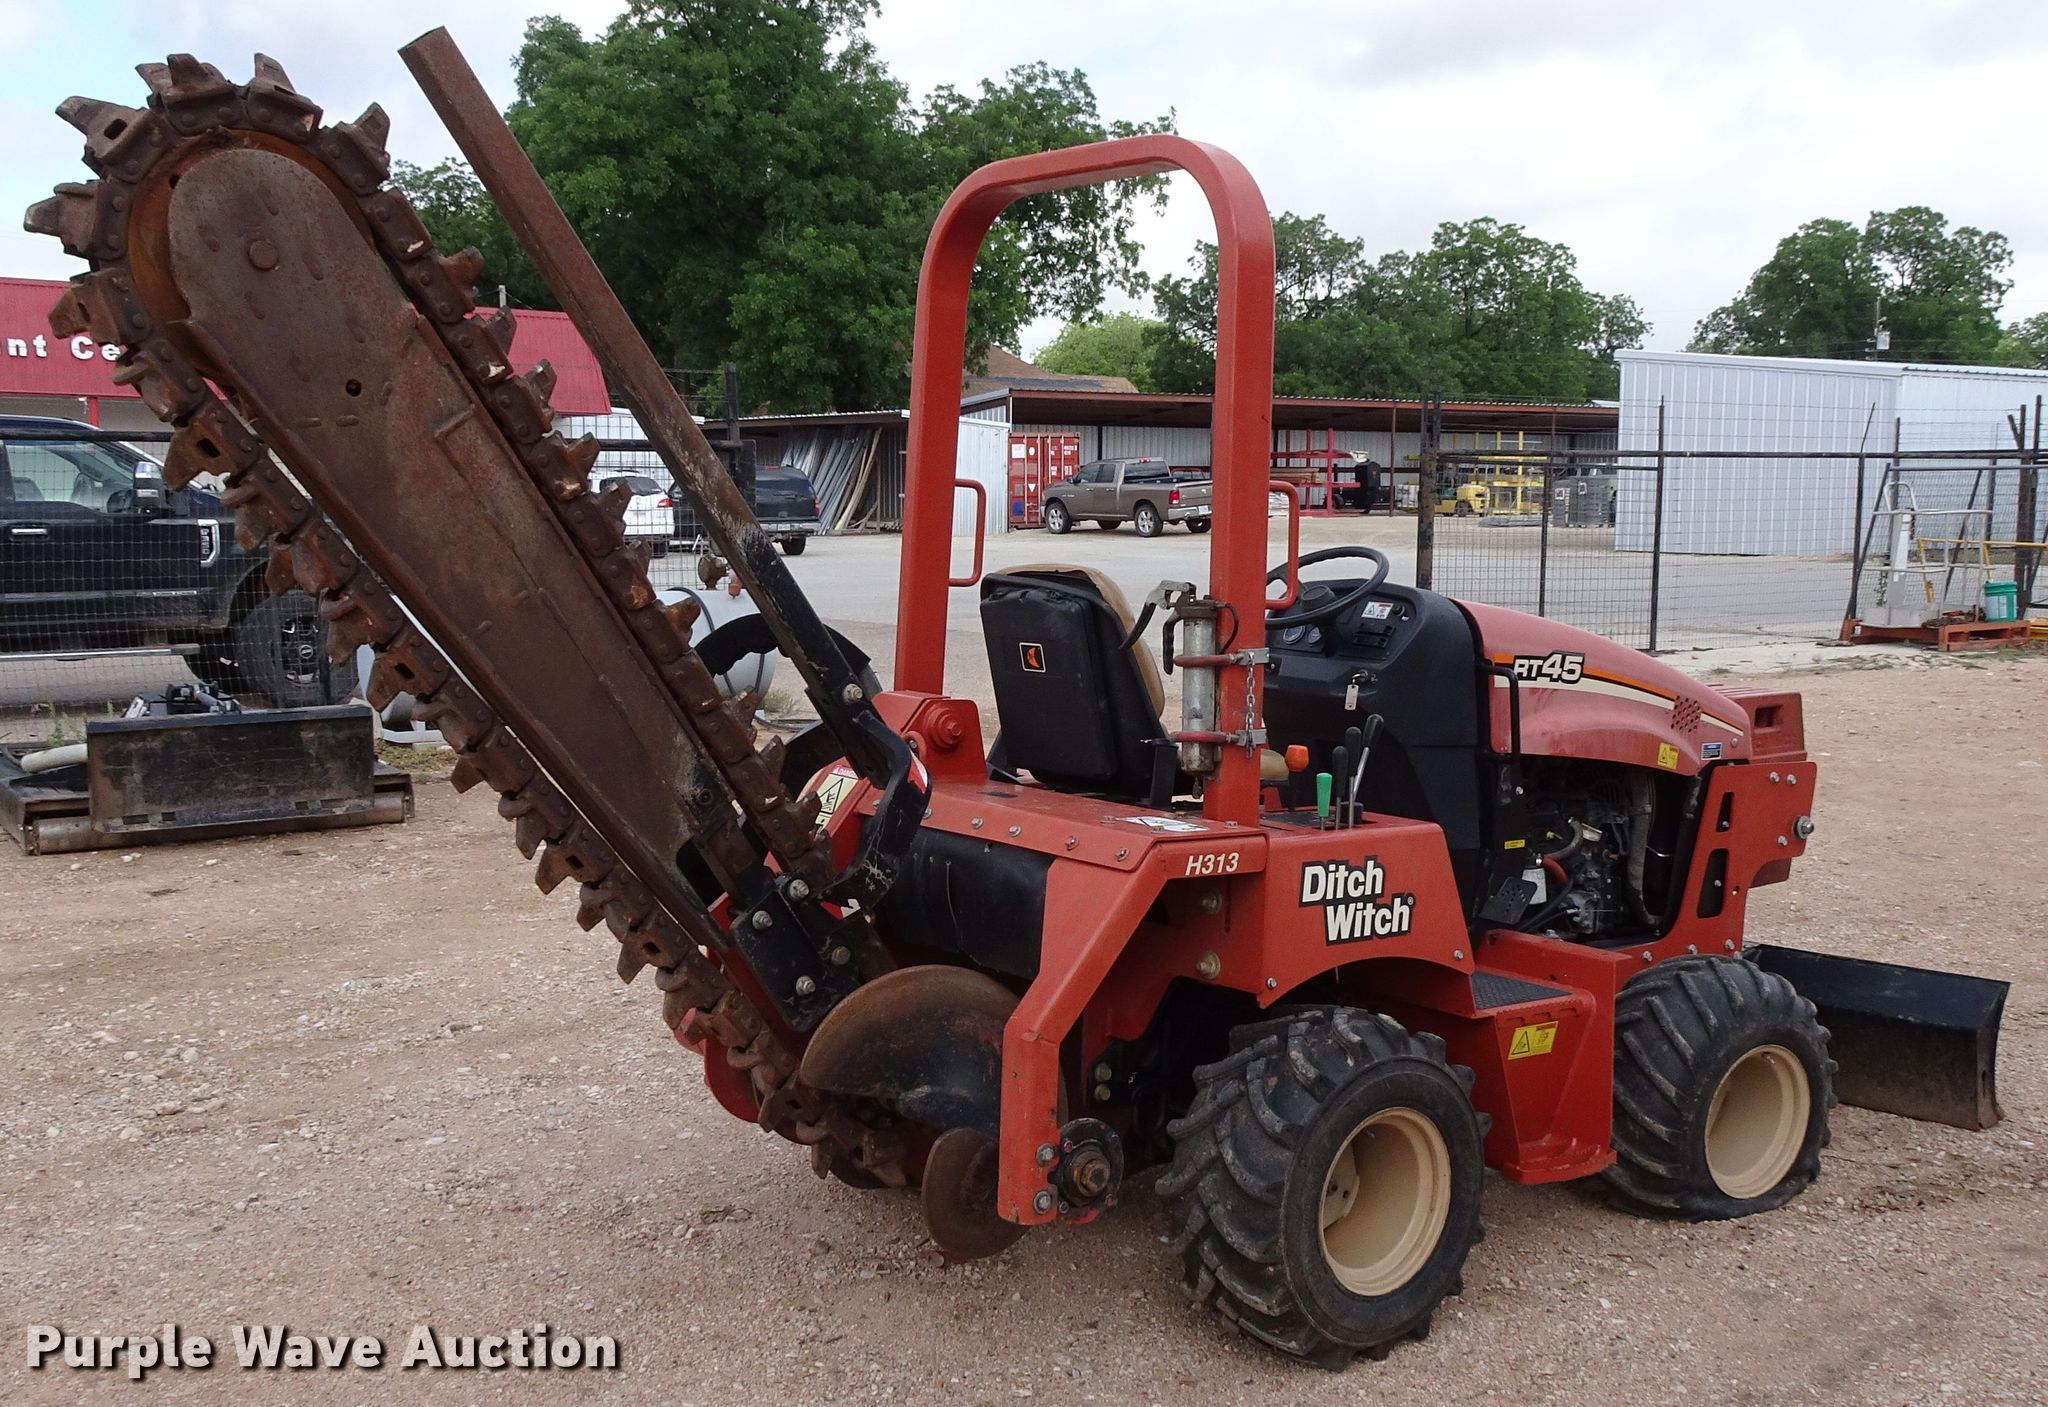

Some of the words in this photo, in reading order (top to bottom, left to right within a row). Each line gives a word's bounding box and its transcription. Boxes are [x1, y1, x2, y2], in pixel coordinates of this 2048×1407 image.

[1513, 653, 1584, 681] RT45
[1185, 852, 1240, 876] H313
[1301, 859, 1384, 903] Ditch
